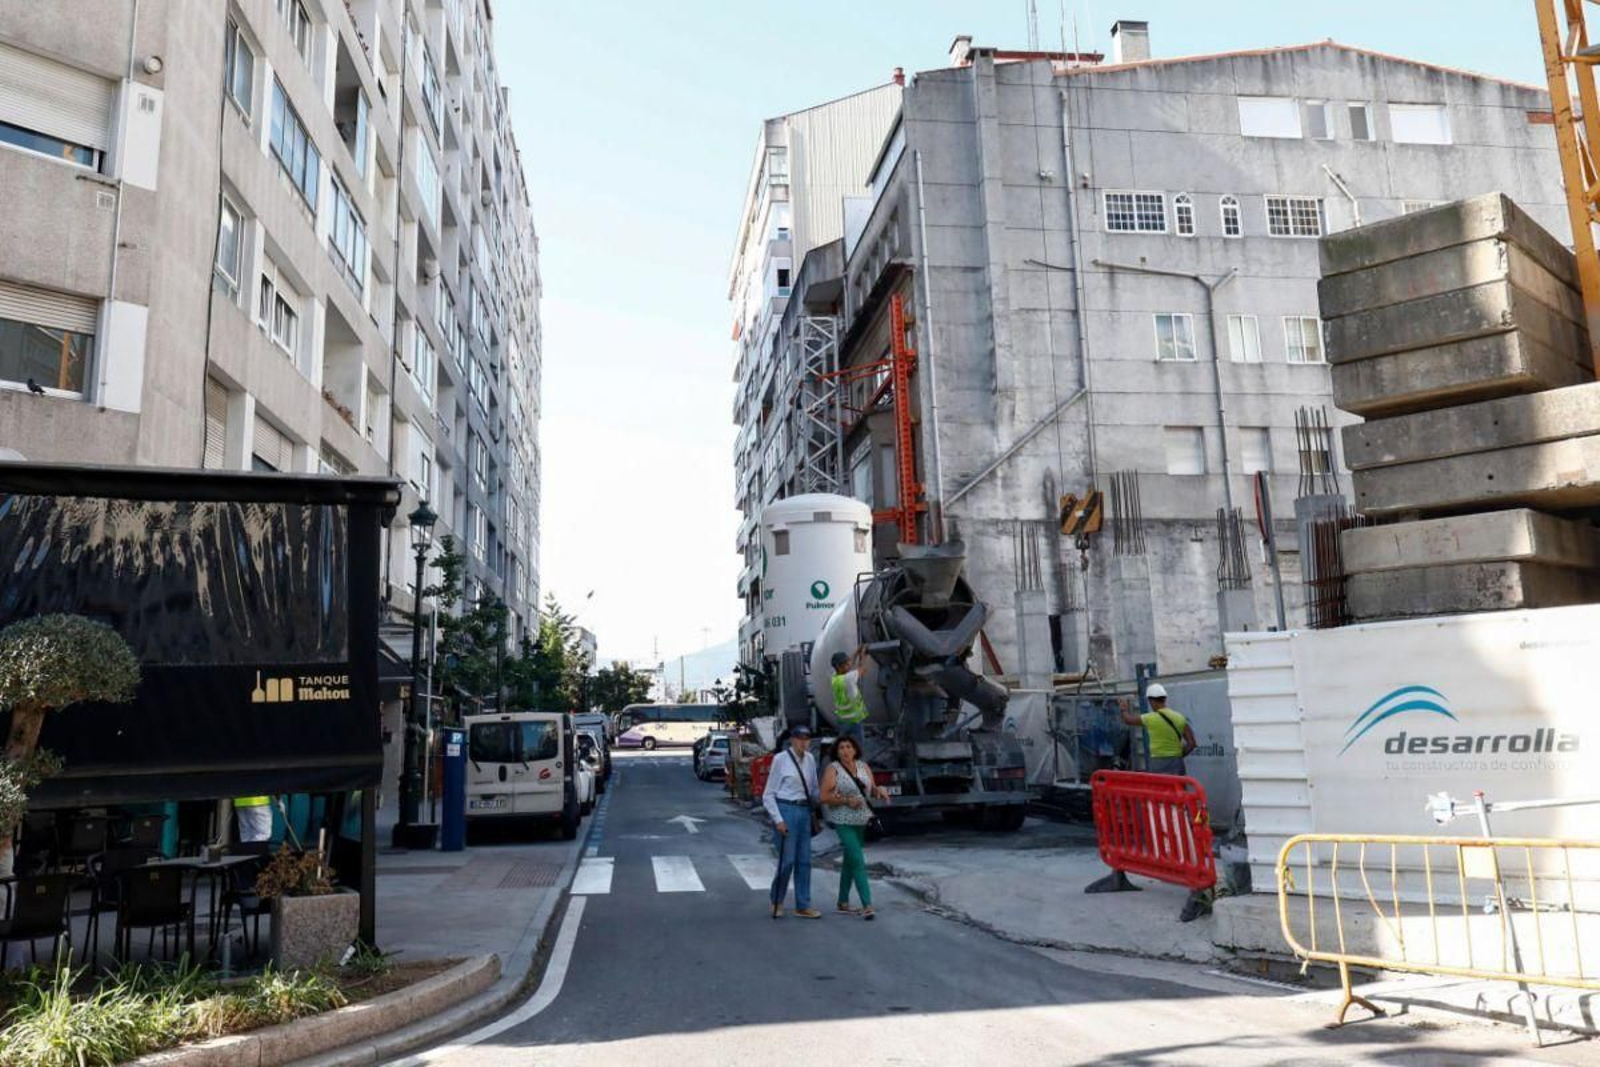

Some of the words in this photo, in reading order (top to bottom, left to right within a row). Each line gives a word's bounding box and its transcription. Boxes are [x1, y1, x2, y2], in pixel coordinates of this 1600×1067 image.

[299, 676, 349, 686] TANQUE
[299, 688, 350, 700] Mahou
[1384, 728, 1580, 754] desarrolla
[1194, 742, 1225, 757] arrolla
[1386, 760, 1400, 771] tu
[1491, 759, 1508, 770] de
